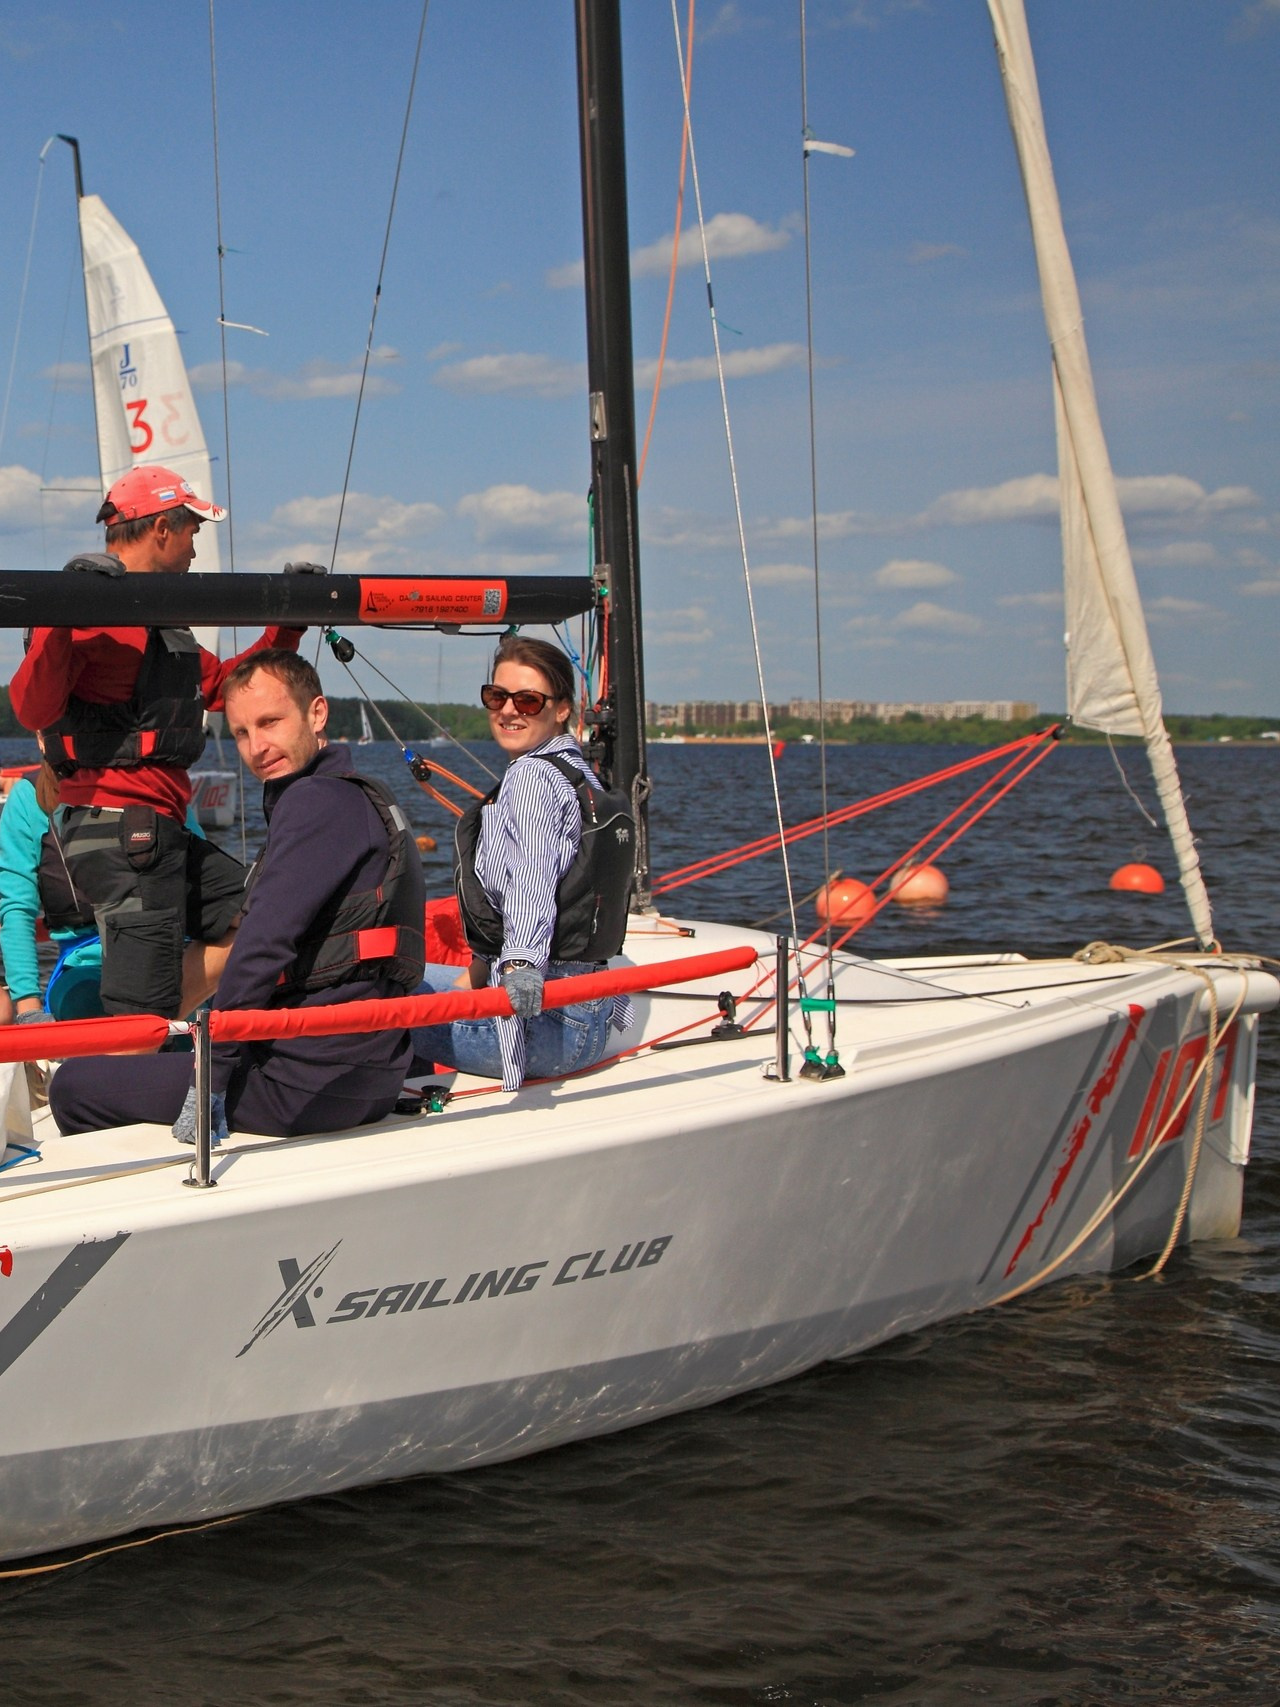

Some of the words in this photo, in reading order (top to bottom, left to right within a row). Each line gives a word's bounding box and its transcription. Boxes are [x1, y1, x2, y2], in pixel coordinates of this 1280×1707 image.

[120, 343, 130, 369] J
[121, 374, 138, 390] 70
[425, 594, 453, 602] SAILING
[455, 594, 483, 602] CENTER
[201, 784, 229, 809] 102
[325, 1260, 549, 1325] SAILING
[551, 1234, 674, 1287] CLUB
